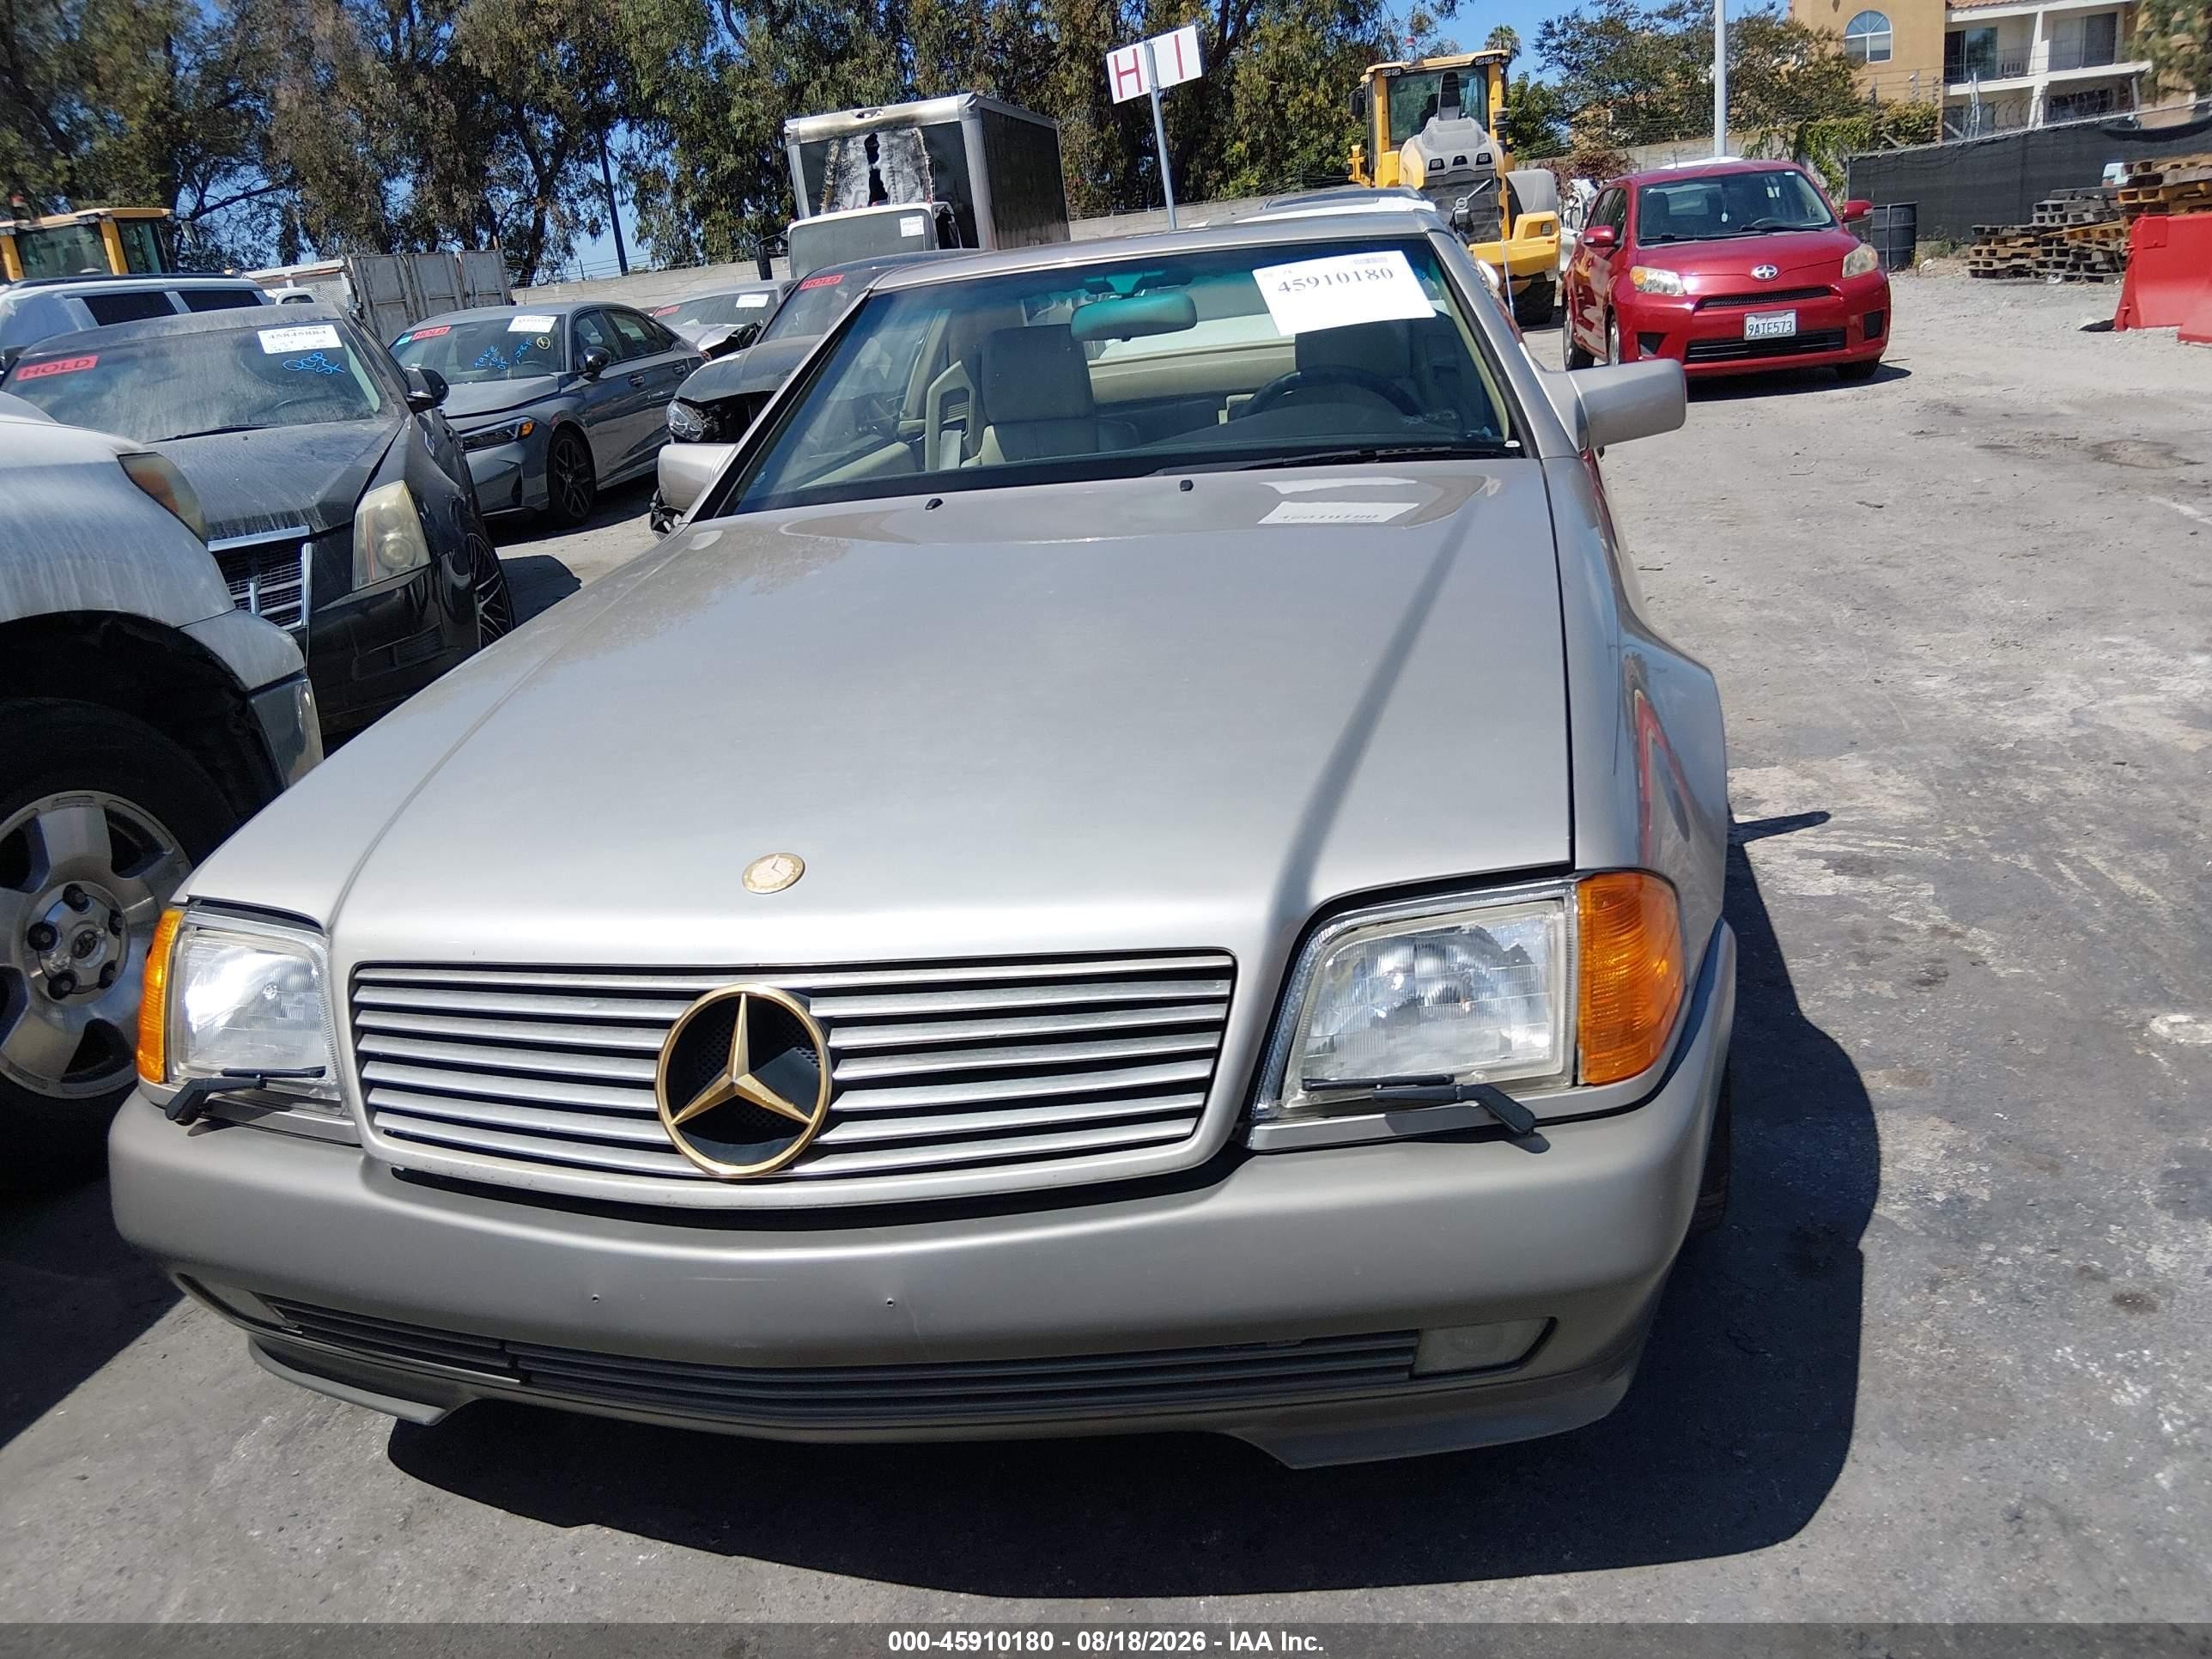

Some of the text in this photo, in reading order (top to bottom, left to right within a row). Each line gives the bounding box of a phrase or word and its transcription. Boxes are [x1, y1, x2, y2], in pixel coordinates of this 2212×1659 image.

[1114, 48, 1143, 99] H
[803, 276, 840, 289] HOLD
[1278, 267, 1394, 293] 45910180
[415, 328, 447, 339] HOLD
[1747, 320, 1793, 336] 9AIE573
[21, 359, 90, 377] HOLD
